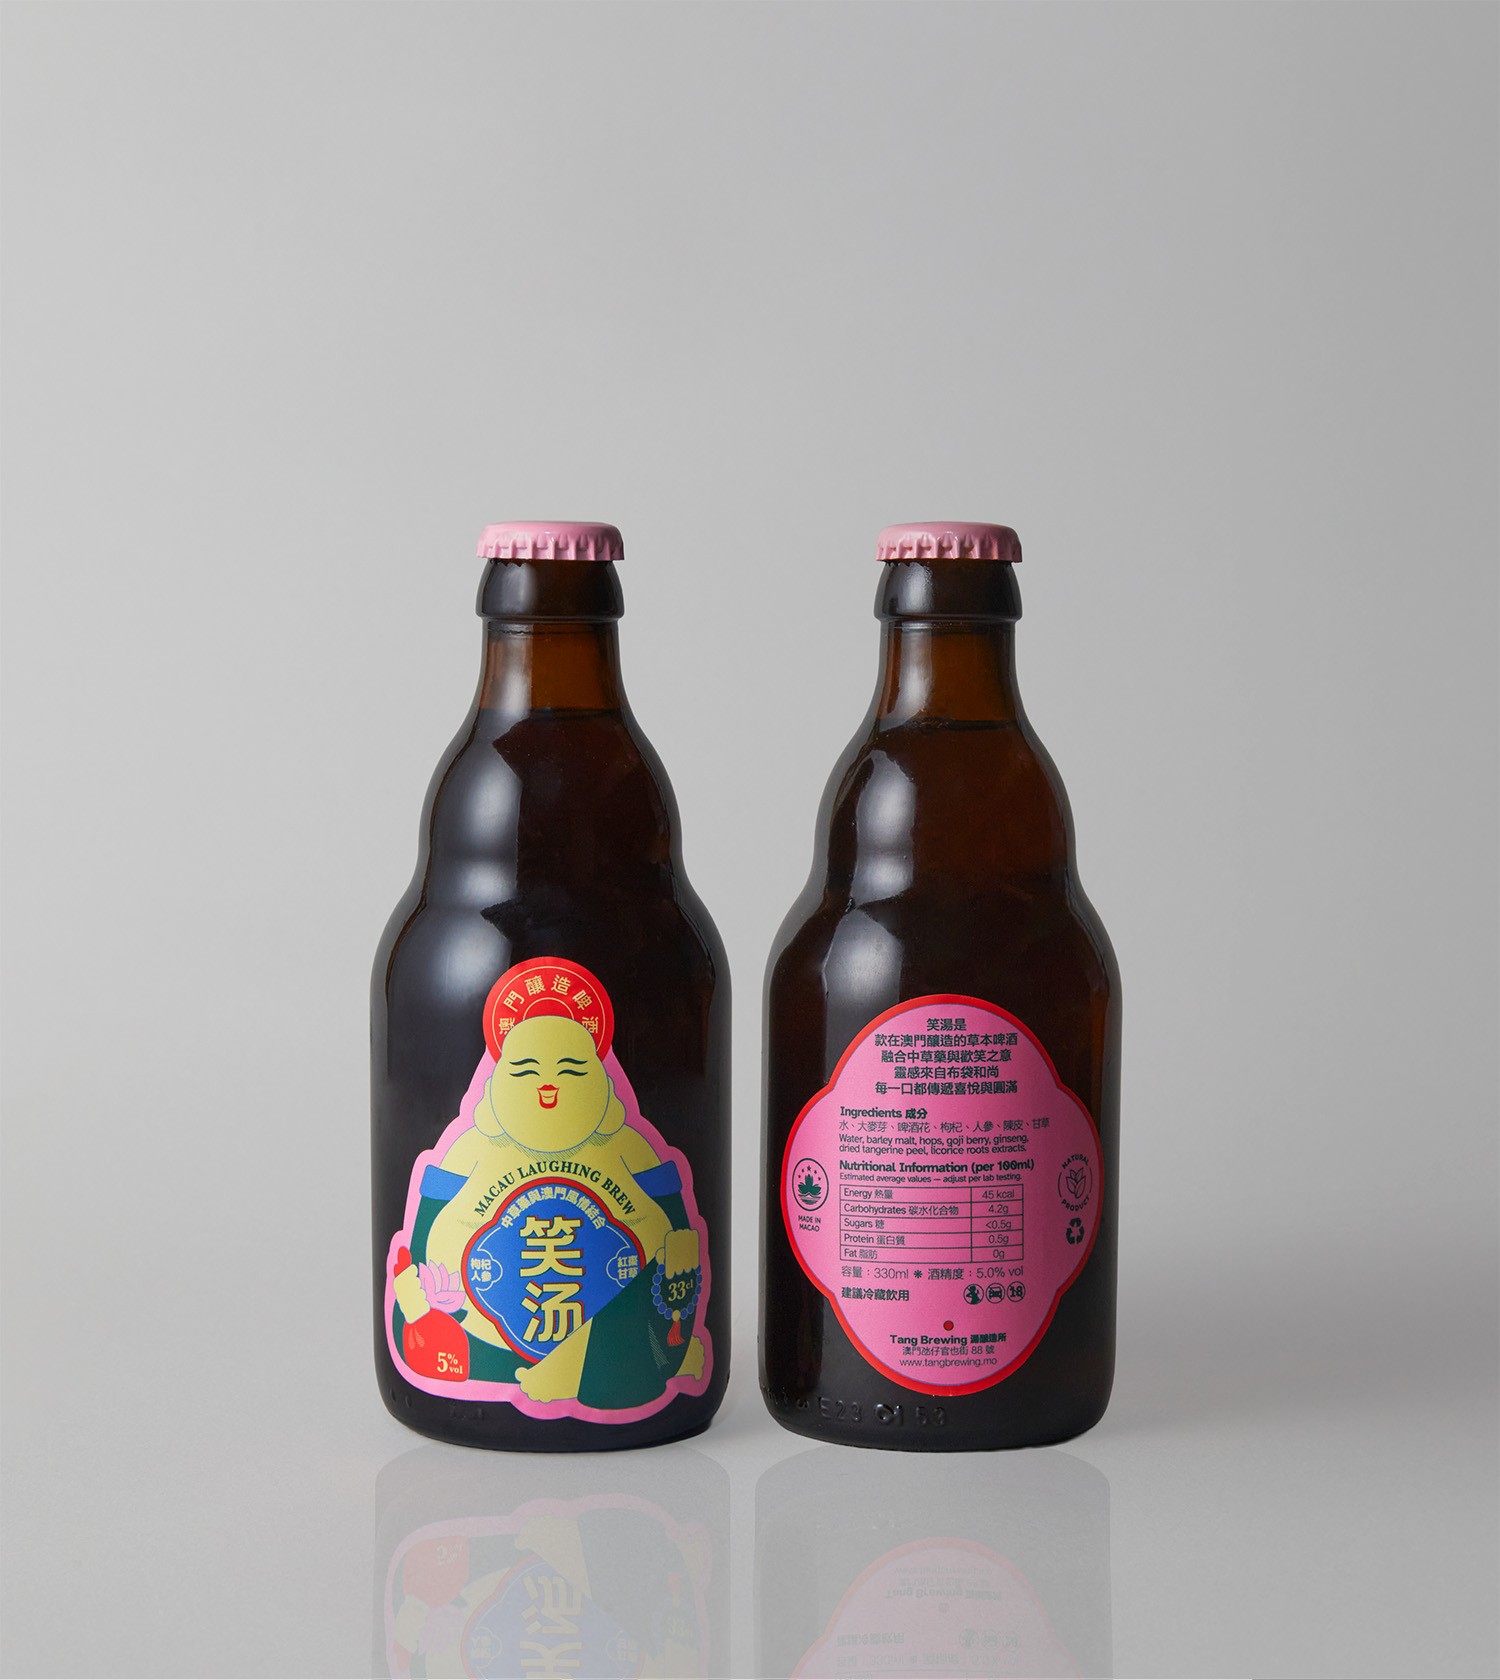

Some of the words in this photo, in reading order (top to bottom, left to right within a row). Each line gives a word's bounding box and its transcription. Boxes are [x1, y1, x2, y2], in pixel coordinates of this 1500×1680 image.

[499, 975, 599, 1035] 澳門釀造啤酒
[927, 1018, 966, 1031] 笑湯是
[875, 1033, 1018, 1047] 款在澳門釀造的草本啤酒
[882, 1049, 1011, 1063] 融合中草藥與歡笑之意
[894, 1066, 999, 1079] 靈感來自布袋和尚
[875, 1080, 1018, 1095] 每一口都傳遞喜悅與圓滿
[840, 1106, 902, 1121] Ingredients
[906, 1109, 927, 1119] 成分
[839, 1134, 864, 1144] Water,
[867, 1134, 892, 1146] barley
[895, 1135, 917, 1145] malt,
[920, 1136, 944, 1147] hops,
[947, 1136, 963, 1147] goji
[966, 1136, 990, 1146] berry,
[839, 1144, 860, 1153] dried
[862, 1145, 903, 1155] tangerine
[906, 1145, 928, 1156] peel,
[931, 1145, 963, 1154] licorice
[967, 1145, 990, 1154] roots
[992, 1144, 1026, 1154] extracts.
[840, 1160, 895, 1172] Nutritional
[900, 1162, 968, 1173] Information
[972, 1162, 994, 1174] (per
[998, 1159, 1034, 1171] 100ml)
[1062, 1154, 1089, 1169] NATURAL
[840, 1173, 874, 1182] Estimated
[876, 1175, 905, 1184] average
[907, 1175, 931, 1183] values
[943, 1174, 966, 1183] adjust
[968, 1175, 981, 1183] per
[996, 1173, 1022, 1182] testing.
[474, 1172, 516, 1216] MACAU
[518, 1161, 602, 1183] LAUGHING
[601, 1177, 636, 1215] BREW
[844, 1188, 871, 1199] Energy
[875, 1189, 893, 1199] 熱量
[982, 1190, 994, 1199] 45
[996, 1189, 1014, 1198] kcal
[988, 1204, 1008, 1214] 4.2g
[1062, 1195, 1089, 1212] PRODUCT
[844, 1204, 906, 1216] Carbohydrates
[909, 1206, 959, 1216] 碳水化合物
[798, 1215, 813, 1223] MADE
[844, 1218, 873, 1229] Sugars
[986, 1220, 1012, 1230] <0.5g
[799, 1224, 820, 1232] MACAO
[844, 1234, 874, 1244] Protein
[877, 1236, 905, 1246] 蛋白質
[988, 1235, 1008, 1245] 0.5g
[844, 1249, 857, 1258] Fat
[993, 1250, 1004, 1259] 0g
[1008, 1266, 1023, 1276] vol
[519, 1216, 586, 1343] 笑汤
[841, 1287, 909, 1301] 建議冷藏飲用
[890, 1334, 917, 1346] Tang
[921, 1335, 967, 1346] Brewing
[971, 1346, 983, 1354] 88
[985, 1345, 995, 1354] 號
[437, 1352, 458, 1372] 5%
[900, 1358, 997, 1368] www.tangbrewing.mo
[449, 1366, 463, 1374] vol
